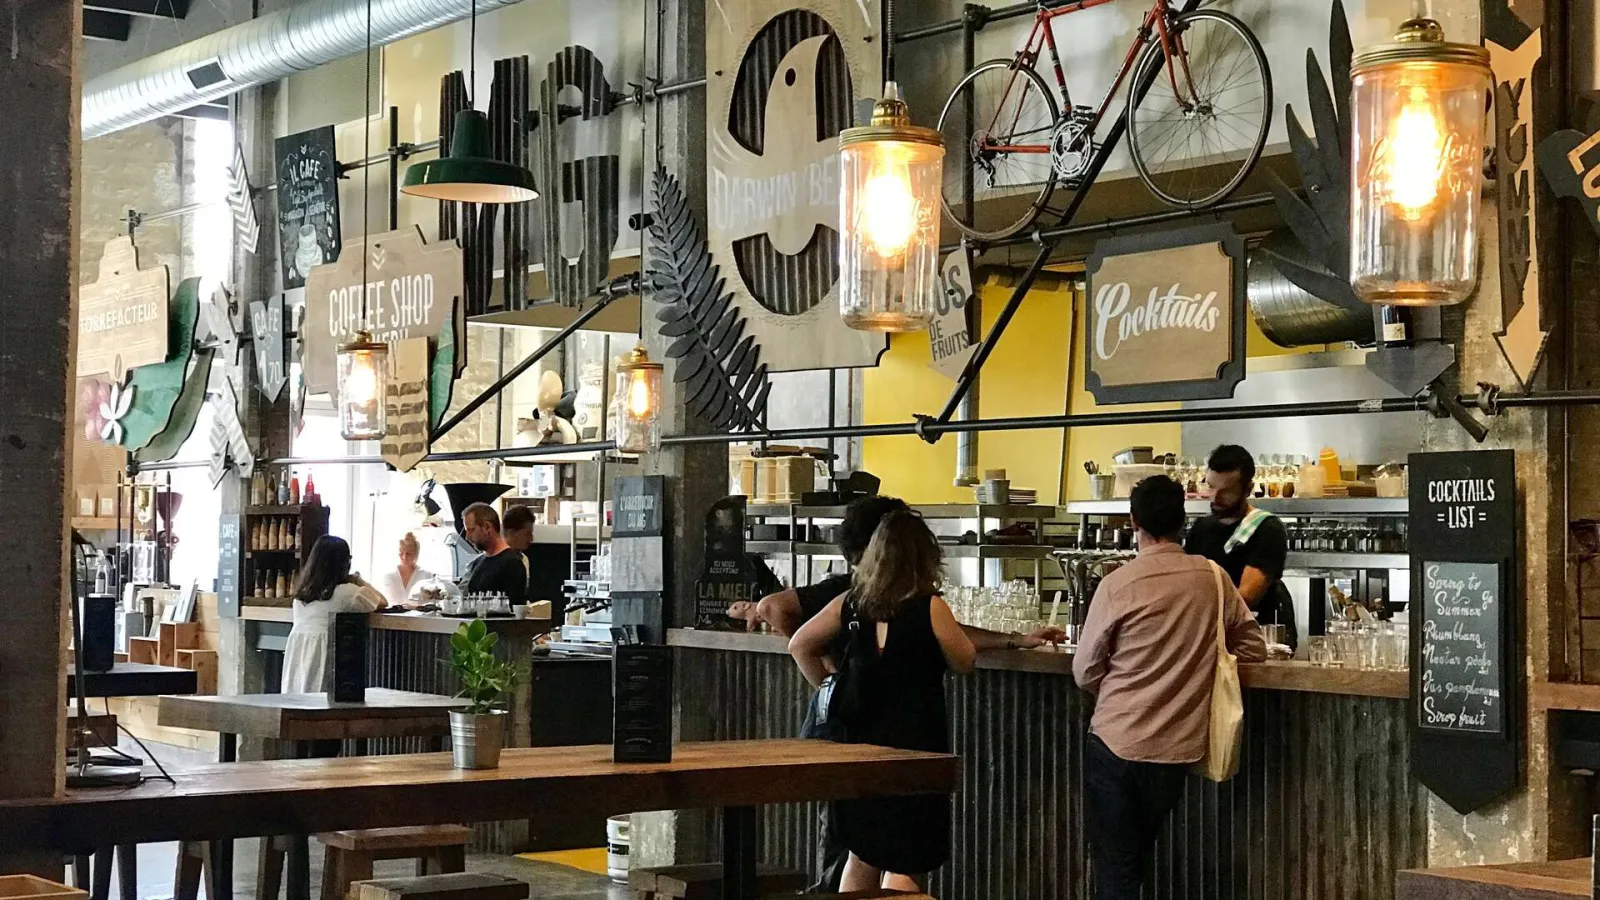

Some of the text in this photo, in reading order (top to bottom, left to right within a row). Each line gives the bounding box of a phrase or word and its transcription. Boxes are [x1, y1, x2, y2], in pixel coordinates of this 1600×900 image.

[713, 165, 797, 230] DARWIN
[1504, 77, 1531, 306] YUMMY
[329, 273, 434, 337] COFFEE SHOP
[1095, 282, 1220, 361] Cocktails
[929, 319, 944, 343] DE
[931, 329, 970, 362] FRUITS
[1428, 479, 1495, 503] COCKTAILS
[699, 582, 715, 599] LA
